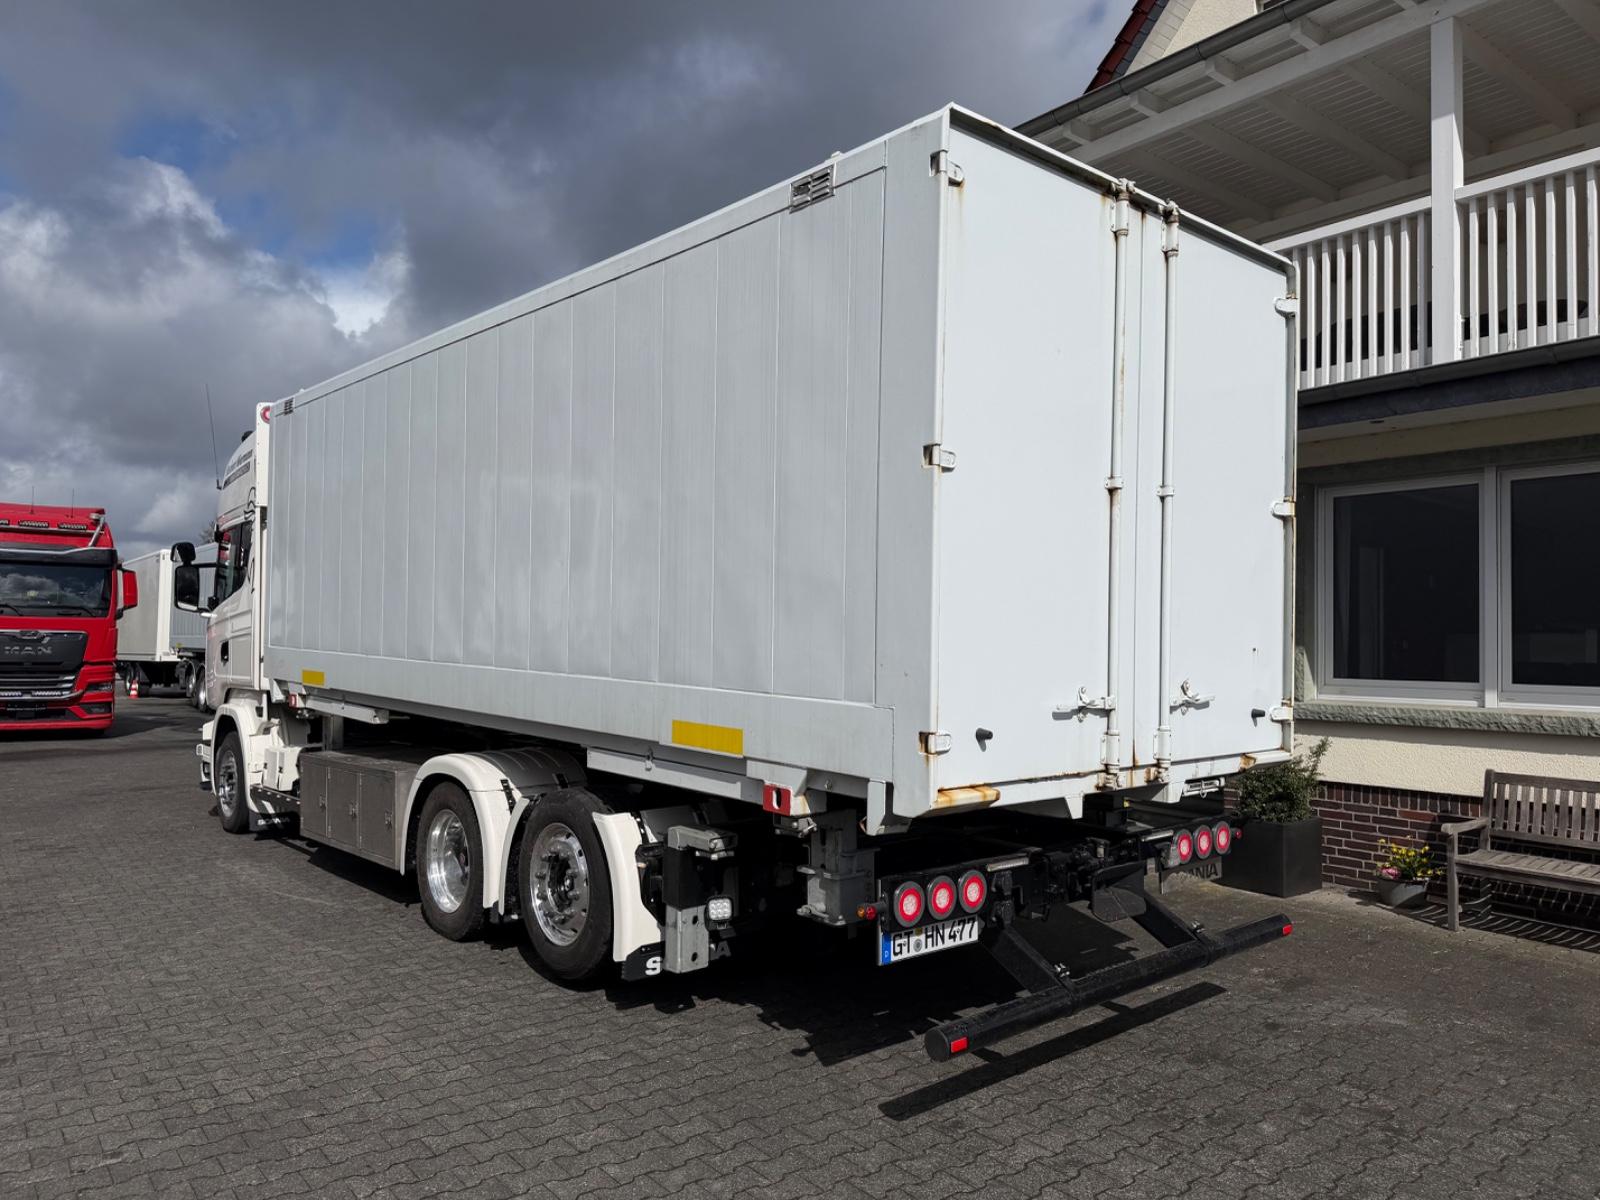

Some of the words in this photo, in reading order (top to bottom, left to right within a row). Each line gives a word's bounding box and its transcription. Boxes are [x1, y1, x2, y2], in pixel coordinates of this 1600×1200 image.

[892, 930, 914, 957] GT
[925, 923, 945, 949] HN
[948, 917, 976, 942] 477
